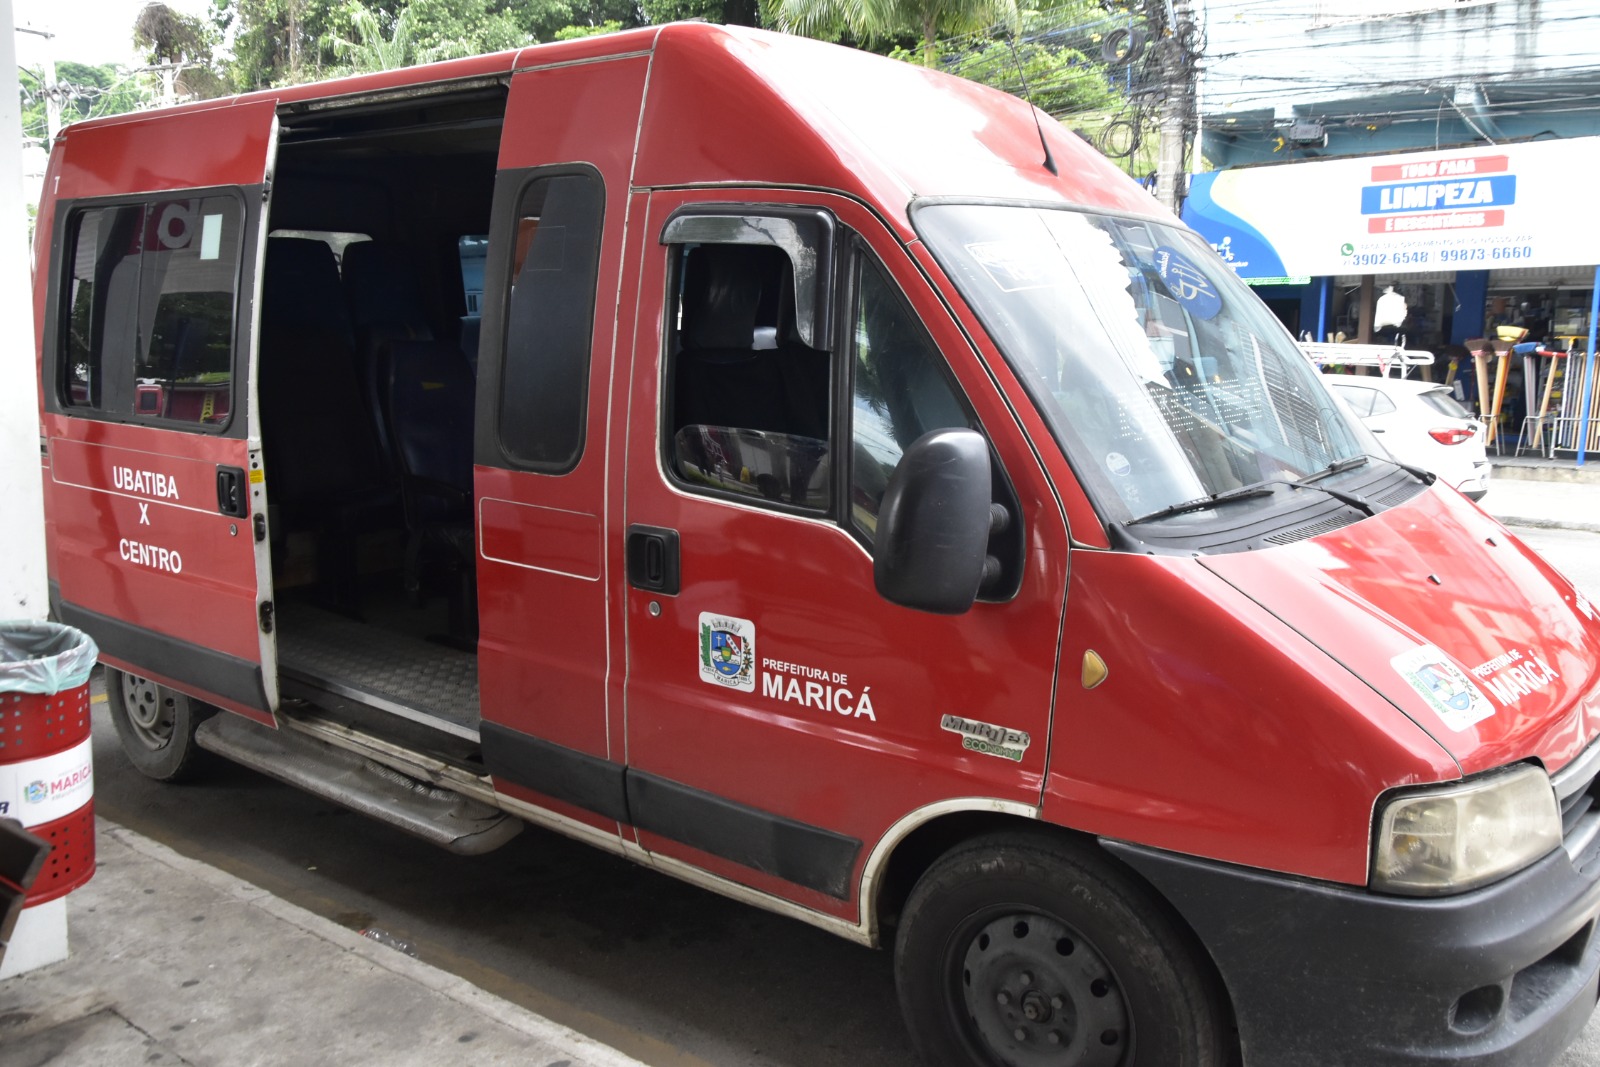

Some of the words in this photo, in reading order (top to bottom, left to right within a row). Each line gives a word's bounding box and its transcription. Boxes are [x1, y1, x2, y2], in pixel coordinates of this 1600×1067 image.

[1401, 160, 1438, 179] TUDO
[1439, 158, 1476, 176] PARA
[1380, 180, 1494, 211] LIMPEZA
[1385, 218, 1394, 232] E
[1352, 251, 1429, 266] 3902-6548
[1440, 245, 1532, 262] 99873-6660
[113, 465, 179, 500] UBATIBA
[138, 502, 151, 526] X
[119, 538, 182, 574] CENTRO
[762, 657, 831, 682] PREFEITURA
[832, 672, 848, 685] DE
[1471, 653, 1513, 680] PREFEITURA
[1484, 649, 1559, 707] MARICÁ
[762, 671, 877, 722] MARICÁ
